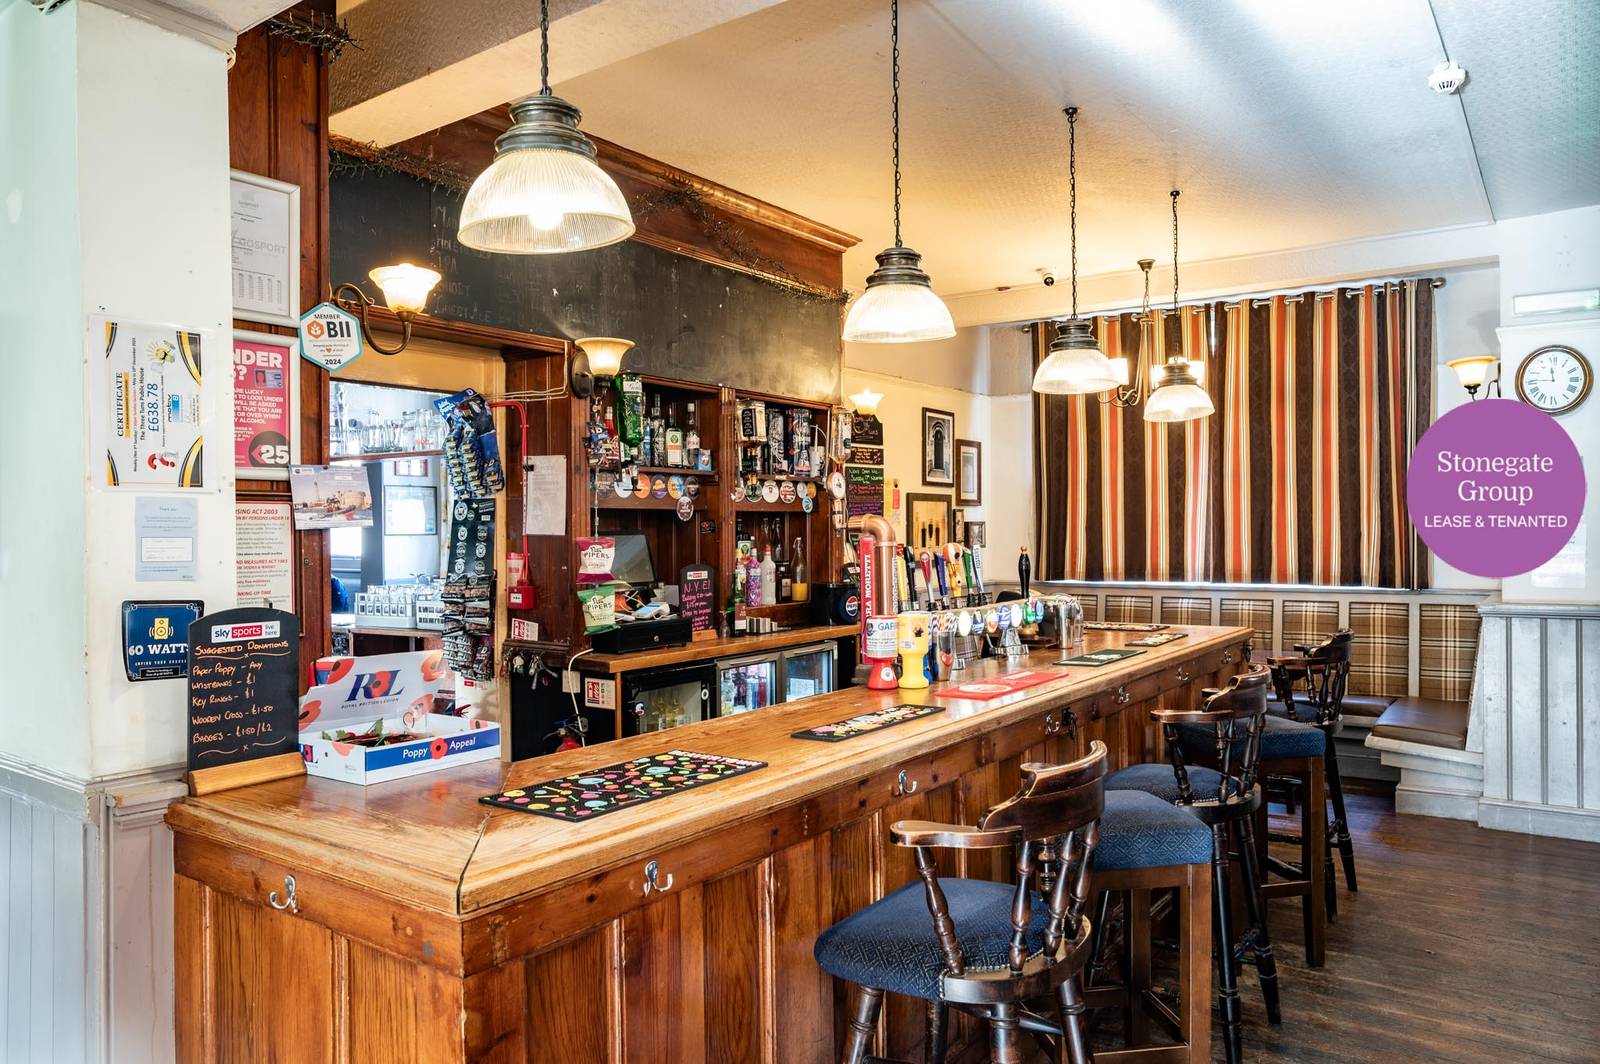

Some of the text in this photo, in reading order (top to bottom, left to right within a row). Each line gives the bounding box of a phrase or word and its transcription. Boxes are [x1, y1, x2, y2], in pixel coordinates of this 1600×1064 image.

[326, 321, 351, 338] BII
[324, 358, 342, 366] 2024
[116, 372, 124, 437] CERTIFICATE
[147, 383, 159, 432] £638.78
[259, 444, 290, 465] 25
[583, 550, 610, 560] PIPERS
[864, 554, 872, 598] MORETTI
[587, 602, 612, 611] PIPERS
[214, 625, 261, 639] sky sports
[128, 644, 144, 656] 60
[402, 736, 476, 760] Poppy Appeal
